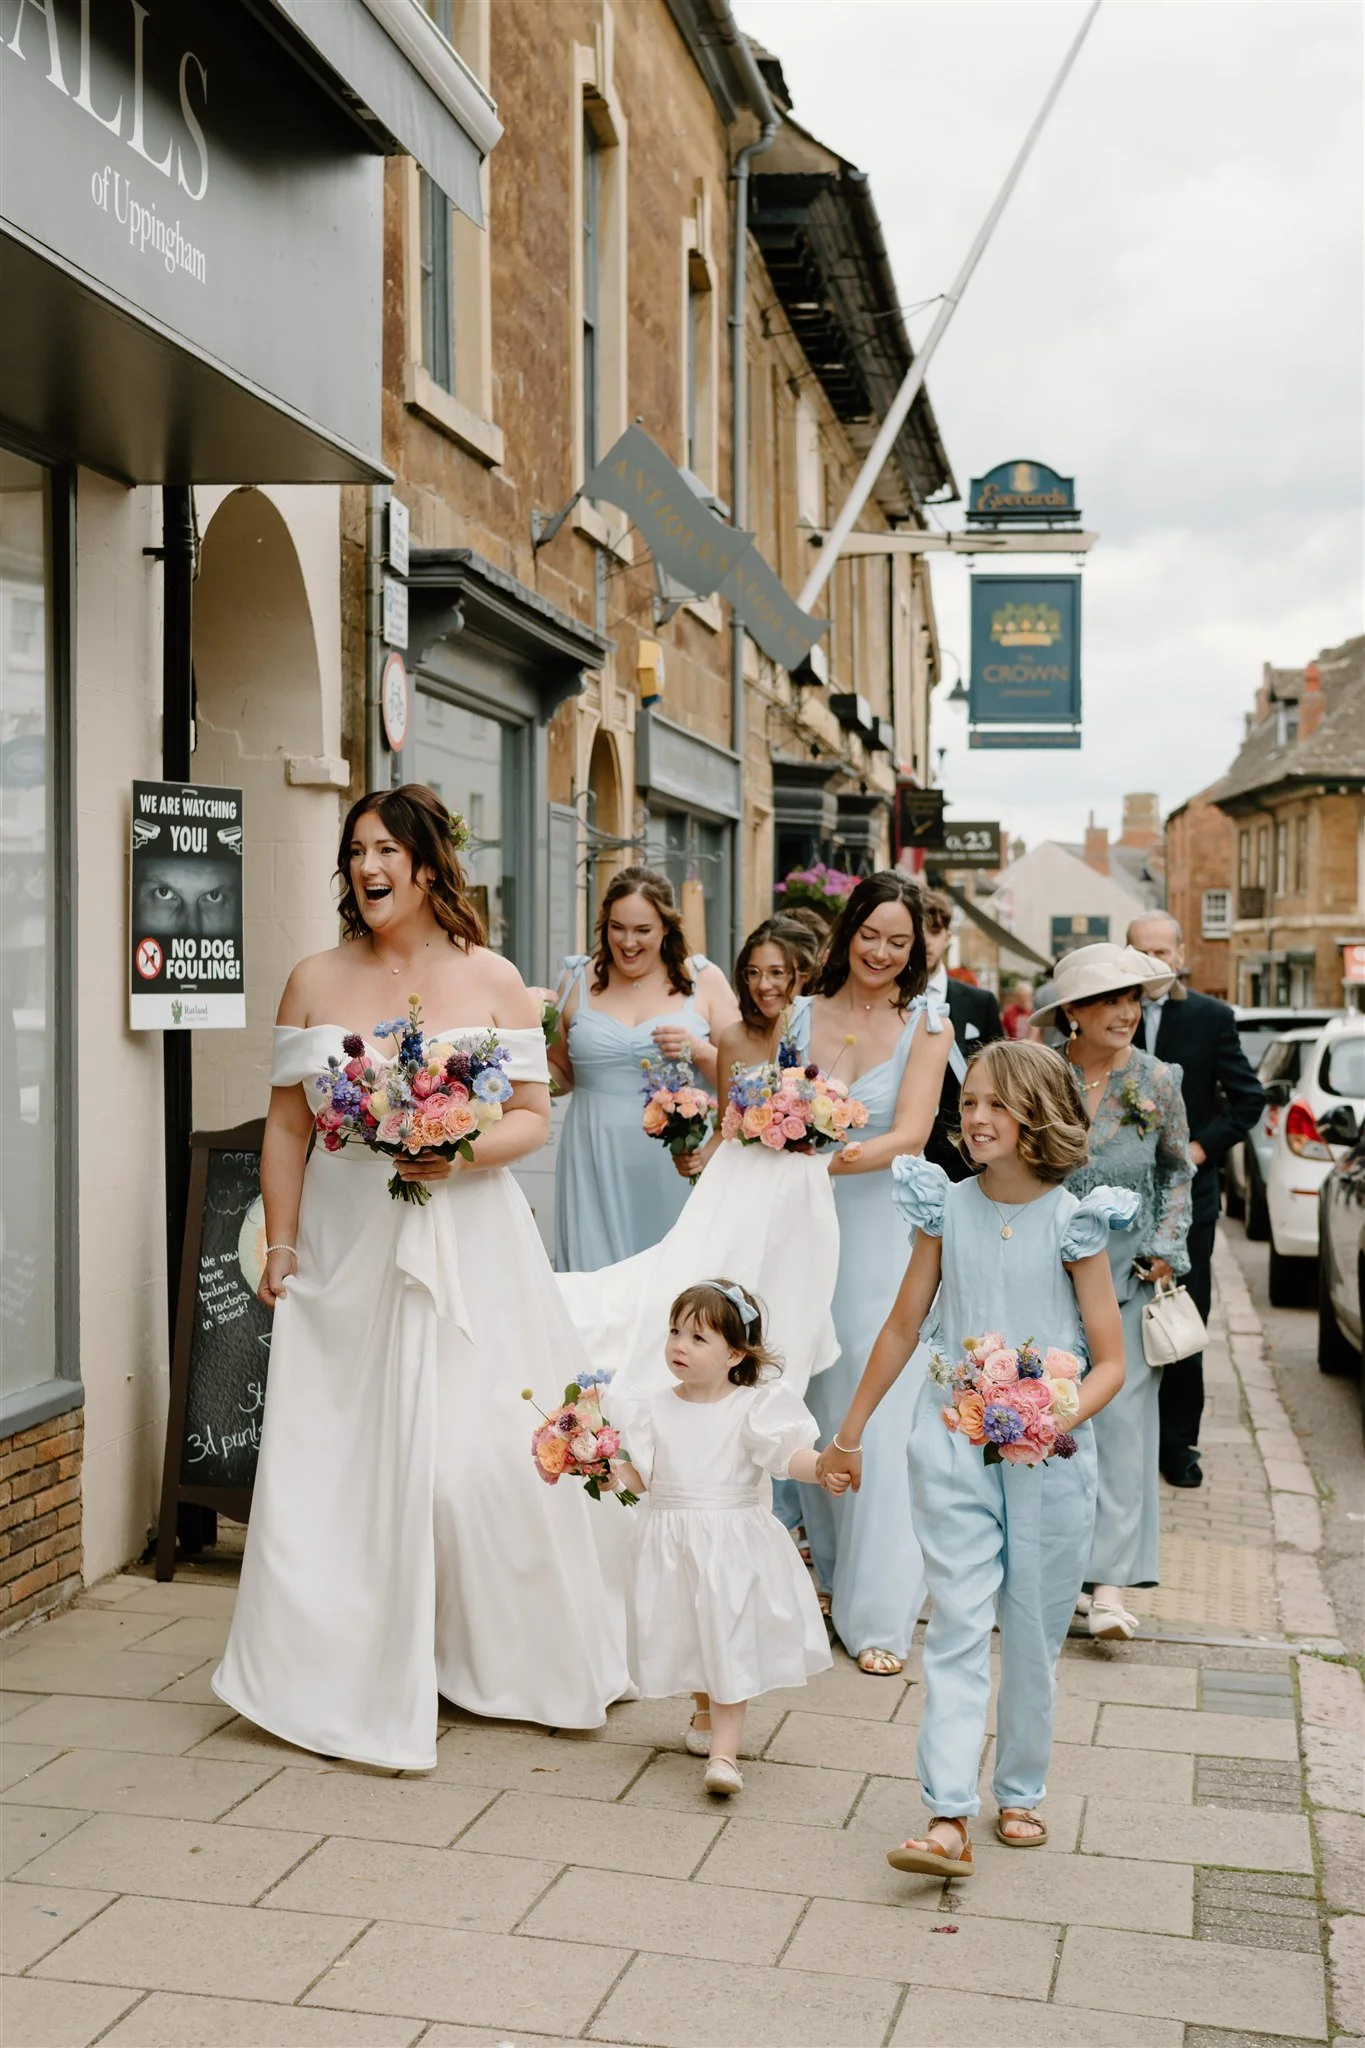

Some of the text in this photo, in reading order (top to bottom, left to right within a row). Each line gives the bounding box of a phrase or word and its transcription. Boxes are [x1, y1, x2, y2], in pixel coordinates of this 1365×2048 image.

[0, 0, 208, 201] ALLS
[91, 165, 207, 285] of Uppingham
[609, 458, 730, 574] ANTIQUES
[735, 564, 810, 651] NTIQUES
[982, 664, 1070, 683] CROWN
[140, 794, 237, 820] WE ARE WATCHING
[169, 825, 208, 853] YOU!
[943, 830, 993, 851] o.23
[171, 938, 235, 959] NO DOG
[166, 959, 241, 980] FOULING!
[201, 1250, 239, 1268] We now
[199, 1269, 224, 1284] have
[199, 1280, 239, 1303] britains
[206, 1291, 251, 1316] tractors
[202, 1318, 214, 1331] in
[187, 1424, 219, 1463] 3d
